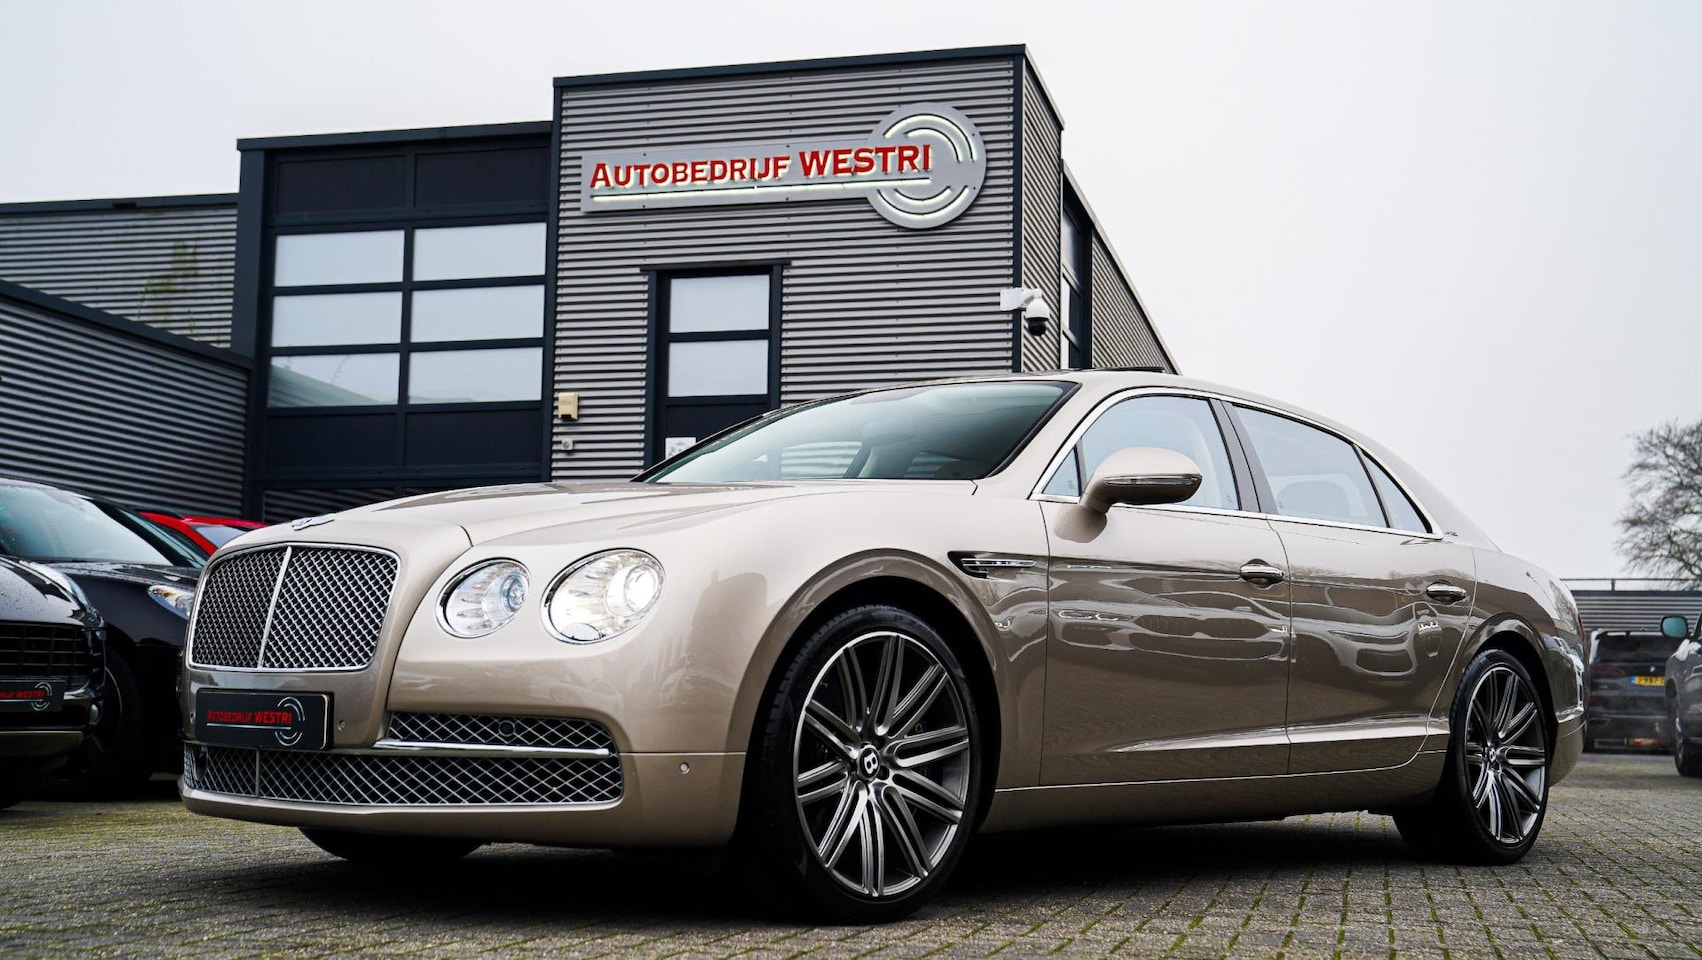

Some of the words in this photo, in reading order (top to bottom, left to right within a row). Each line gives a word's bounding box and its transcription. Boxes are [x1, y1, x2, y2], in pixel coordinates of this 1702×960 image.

[589, 155, 791, 188] AUTOBEDRIJF
[798, 143, 932, 178] WESTRI
[253, 711, 293, 724] WESTRI
